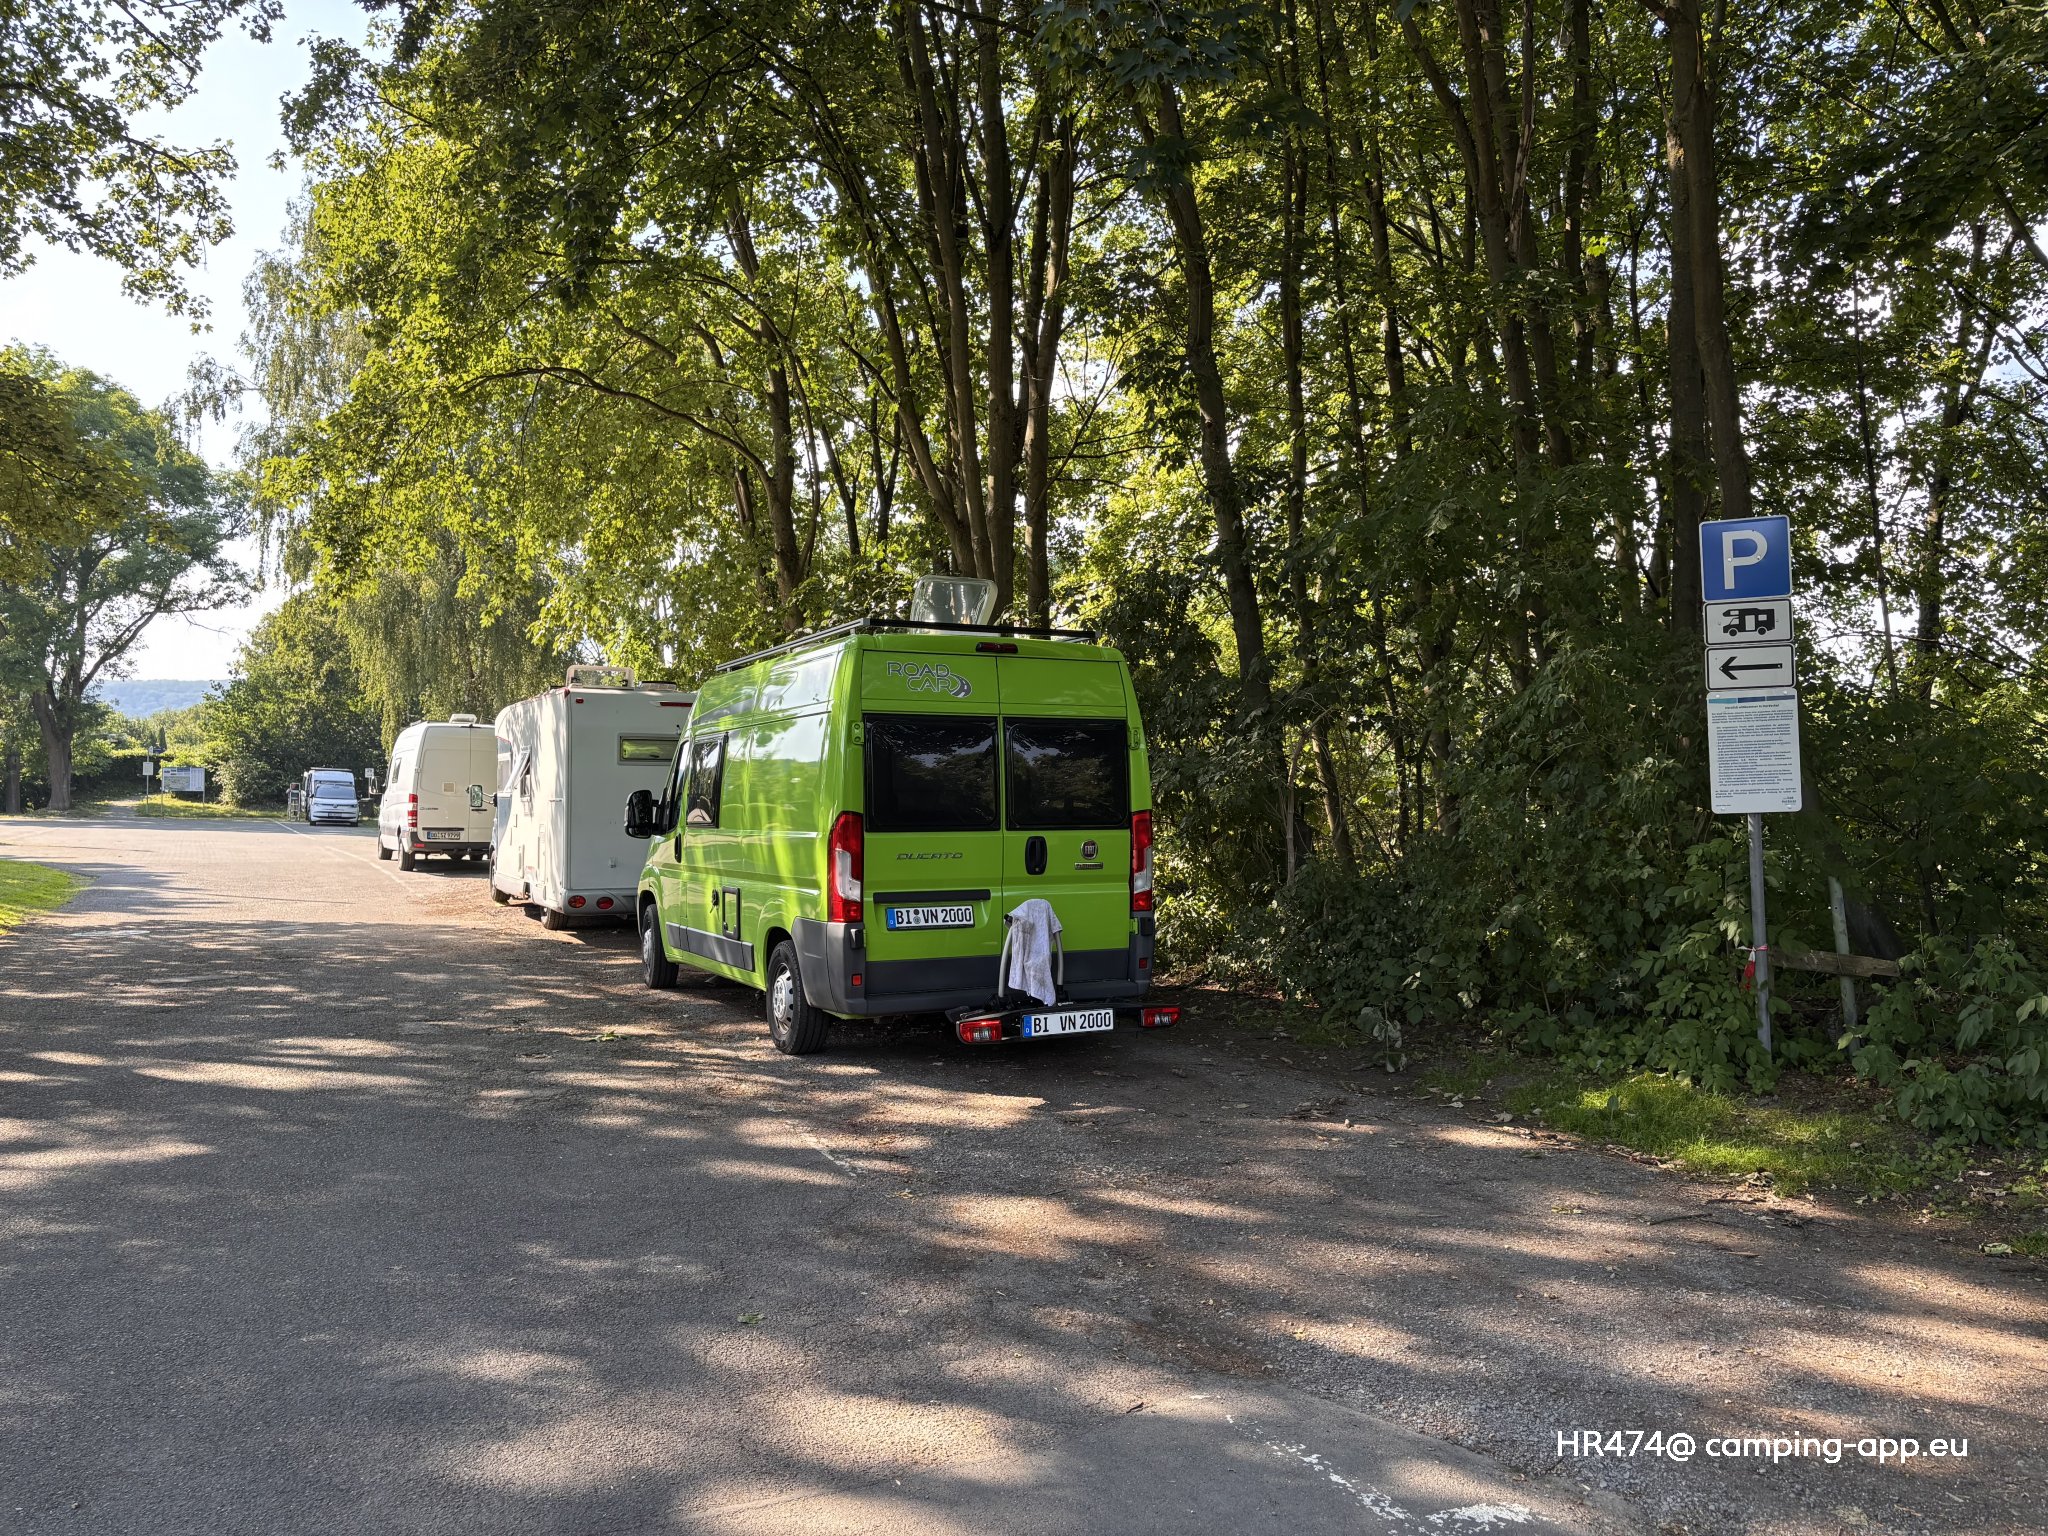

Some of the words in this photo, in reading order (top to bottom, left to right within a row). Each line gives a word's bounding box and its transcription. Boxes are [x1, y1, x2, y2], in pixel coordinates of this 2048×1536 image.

[1721, 530, 1768, 590] P
[886, 661, 951, 678] ROAD
[906, 676, 952, 692] CAR
[896, 852, 963, 860] DUCATO
[896, 909, 912, 925] BI
[922, 909, 939, 924] VN
[941, 907, 972, 923] 2000
[1033, 1016, 1049, 1033] BI
[1060, 1014, 1077, 1031] VN
[1080, 1012, 1111, 1029] 2000
